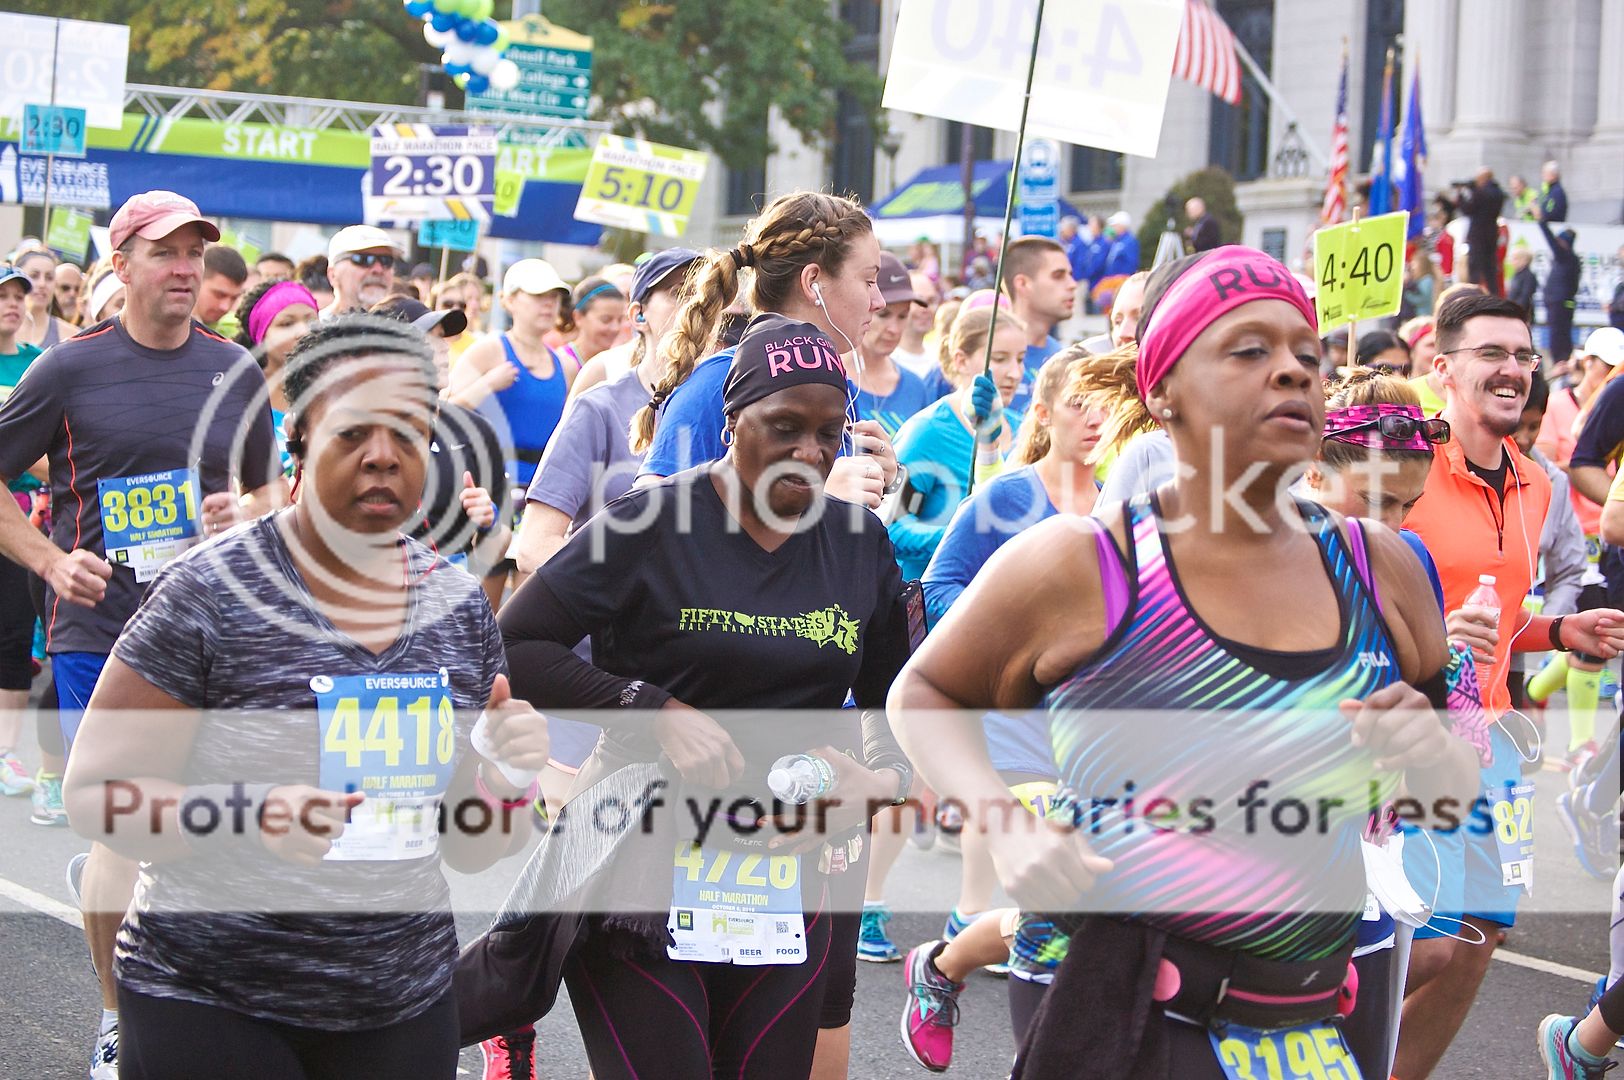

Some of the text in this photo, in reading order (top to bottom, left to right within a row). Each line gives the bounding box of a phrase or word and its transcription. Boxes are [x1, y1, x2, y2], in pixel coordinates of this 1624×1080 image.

[28, 114, 80, 138] 2:30
[222, 126, 318, 160] START
[20, 157, 108, 175] EVESOURCE
[496, 146, 554, 177] ART
[20, 172, 109, 188] HATFORD
[382, 155, 484, 195] 2:30
[597, 167, 684, 211] 5:10
[1322, 243, 1394, 293] 4:40
[765, 336, 814, 353] BLACK
[126, 472, 172, 486] EVERSOURCE
[102, 480, 197, 533] 3831
[679, 622, 711, 632] HALF
[721, 623, 787, 637] MARATHON
[680, 608, 826, 631] FIFTY STATES
[1358, 651, 1391, 667] FILA
[365, 677, 437, 690] EVERSOURCE
[324, 695, 455, 768] 4418
[363, 774, 437, 789] HALF MARATHON
[699, 890, 769, 906] HALF MARATHON
[1219, 1027, 1360, 1080] 3195
